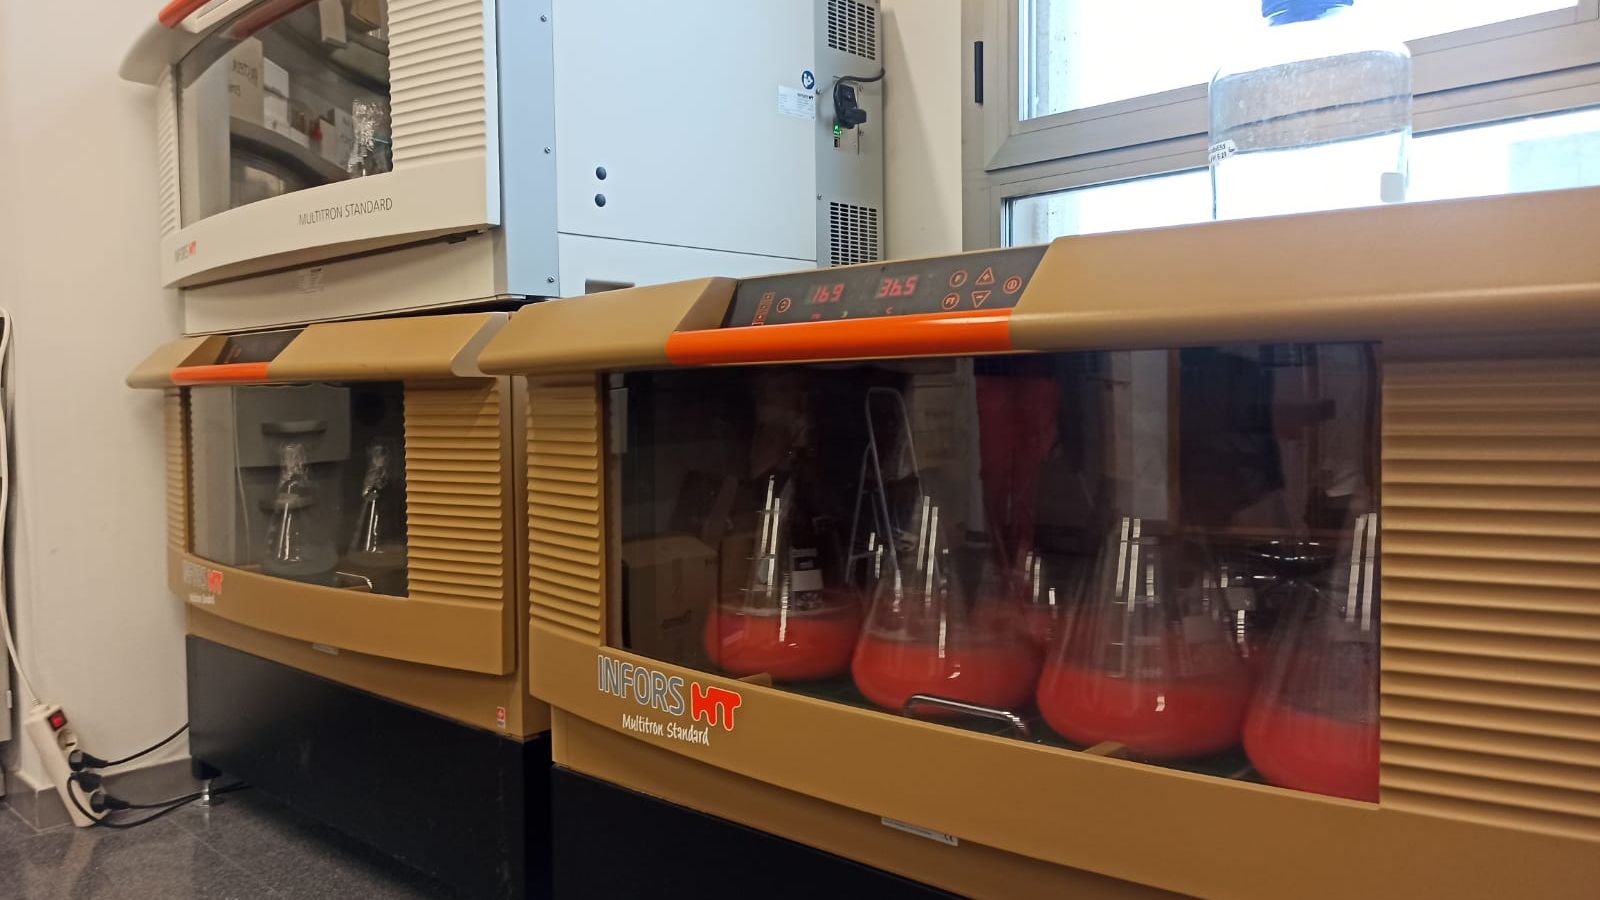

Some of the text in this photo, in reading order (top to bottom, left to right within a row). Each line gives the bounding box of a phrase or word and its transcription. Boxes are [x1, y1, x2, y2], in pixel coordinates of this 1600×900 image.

[299, 197, 393, 225] MULTITRON STANDARD
[597, 654, 742, 732] INFORS HT
[622, 713, 710, 746] Multitron Standard
